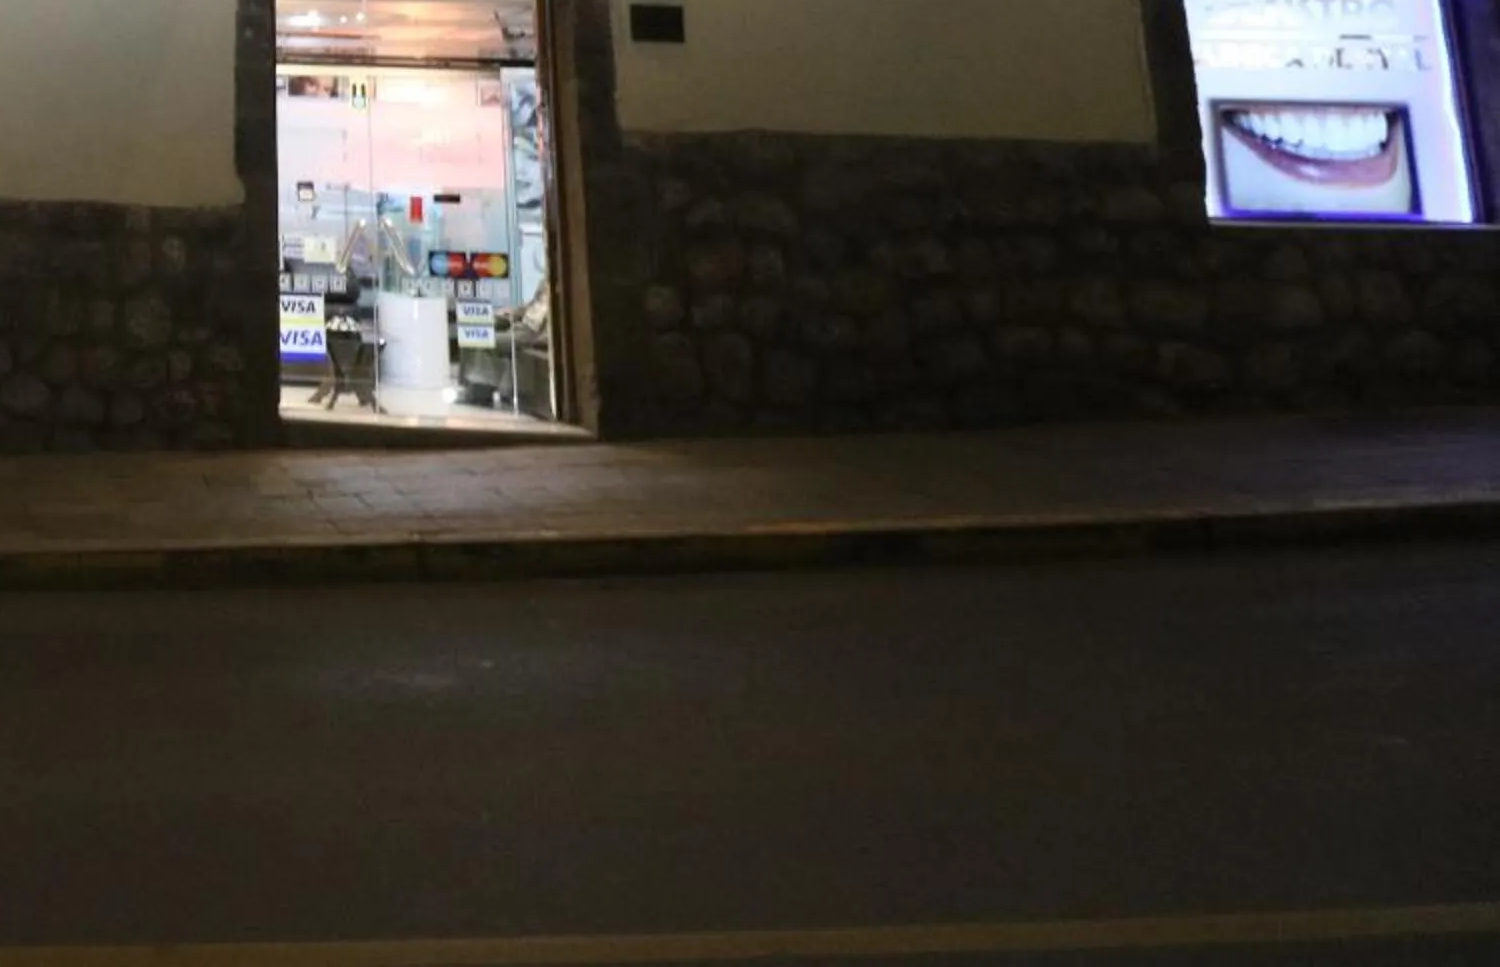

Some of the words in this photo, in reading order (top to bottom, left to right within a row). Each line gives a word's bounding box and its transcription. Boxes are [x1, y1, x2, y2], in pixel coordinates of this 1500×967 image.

[281, 300, 317, 313] VISA
[463, 306, 489, 316] VISA
[280, 329, 323, 345] VISA
[464, 329, 489, 339] VISA
